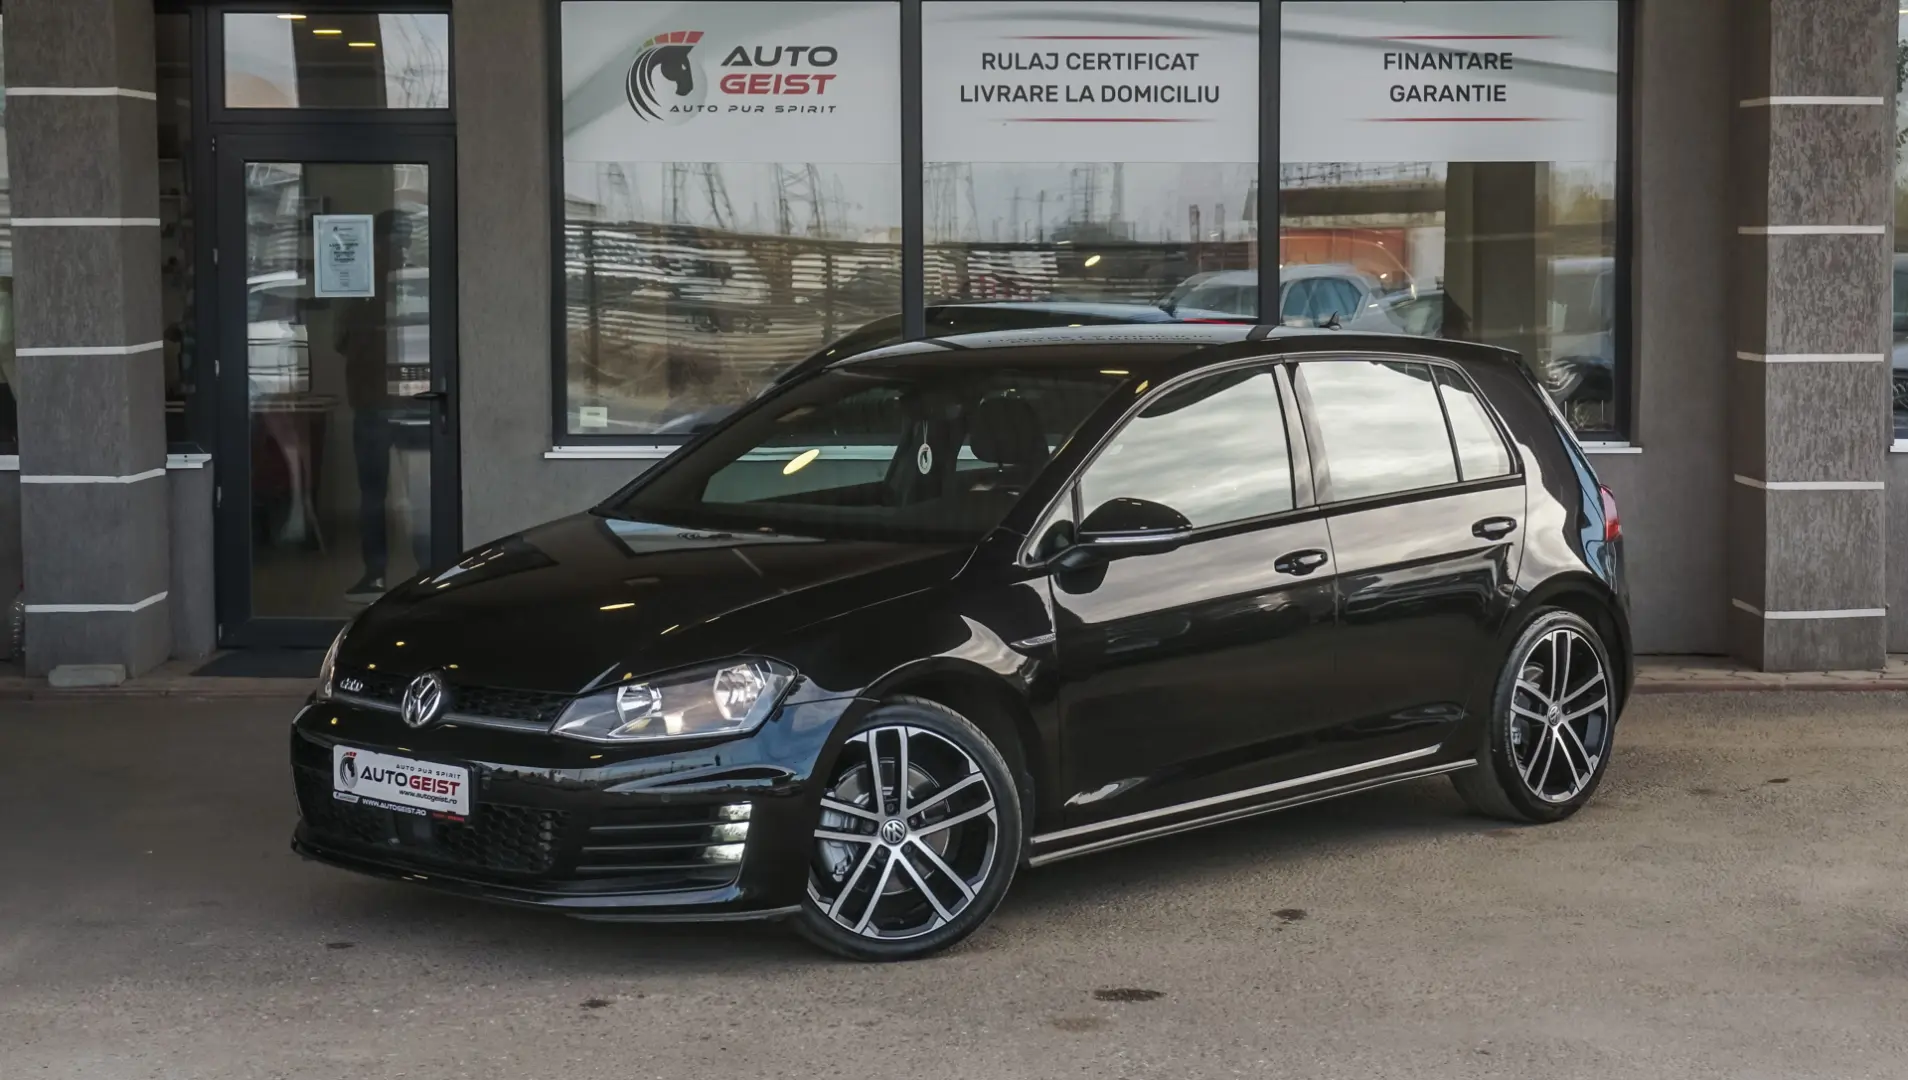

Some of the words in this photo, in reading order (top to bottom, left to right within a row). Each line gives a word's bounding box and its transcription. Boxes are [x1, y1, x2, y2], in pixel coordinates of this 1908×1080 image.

[721, 45, 838, 67] AUTO
[982, 52, 1059, 71] RULAJ
[1066, 52, 1199, 71] CERTIFICAT
[1384, 51, 1513, 71] FINANTARE
[720, 74, 837, 95] GEIST
[1389, 84, 1507, 103] GARANTIE
[960, 85, 1058, 102] LIVRARE
[1065, 85, 1095, 102] LA
[1101, 85, 1220, 103] DOMICILIU
[669, 105, 718, 113] AUTO
[728, 105, 765, 113] PUR
[775, 105, 837, 113] SPIRIT
[396, 764, 415, 772] AUTO
[435, 771, 461, 780] SPIRIT
[399, 789, 458, 805] www.autogeist.ro
[362, 798, 427, 816] WWW.AUTOGEIST.RO
